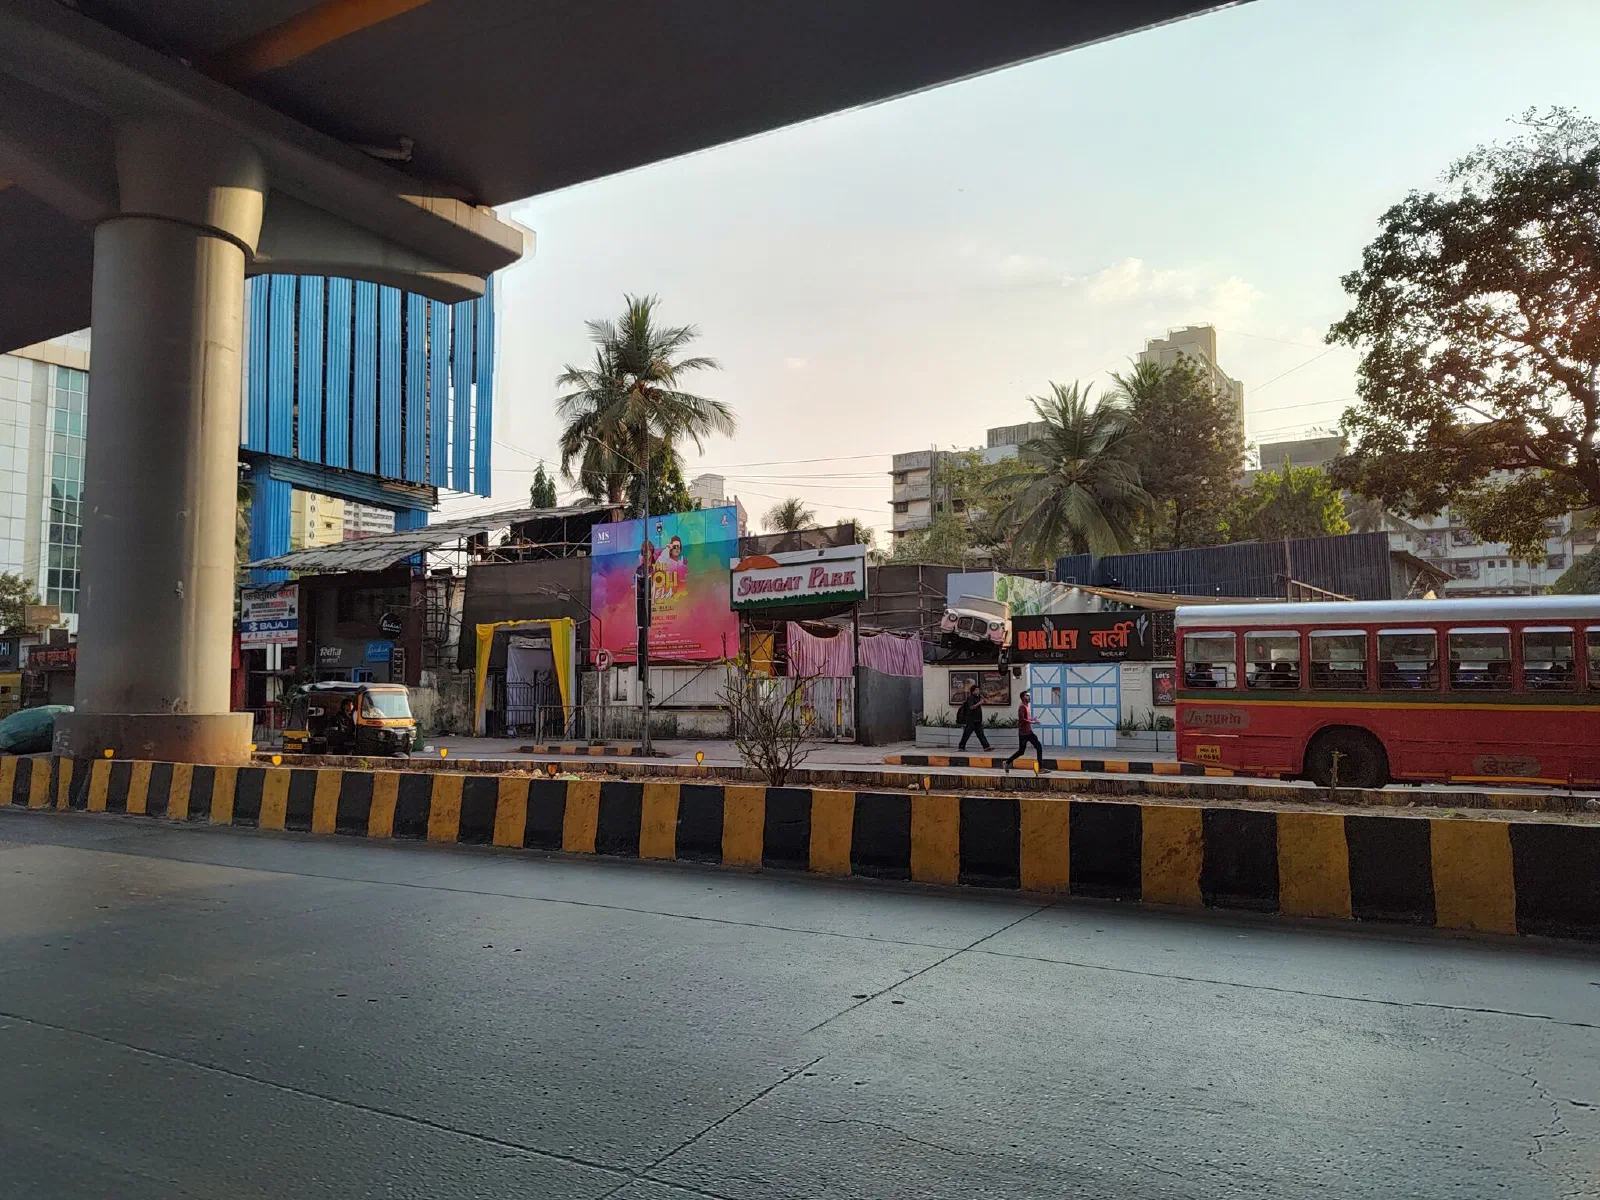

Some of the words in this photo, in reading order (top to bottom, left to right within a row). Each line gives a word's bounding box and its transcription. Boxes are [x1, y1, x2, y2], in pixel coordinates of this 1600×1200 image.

[652, 571, 677, 587] OLI
[737, 575, 803, 597] SWAGAT
[807, 567, 856, 589] PARK
[259, 621, 289, 630] BAJAJ
[1018, 629, 1079, 650] BARLEY
[1088, 621, 1135, 649] बार्ली
[599, 653, 607, 666] P
